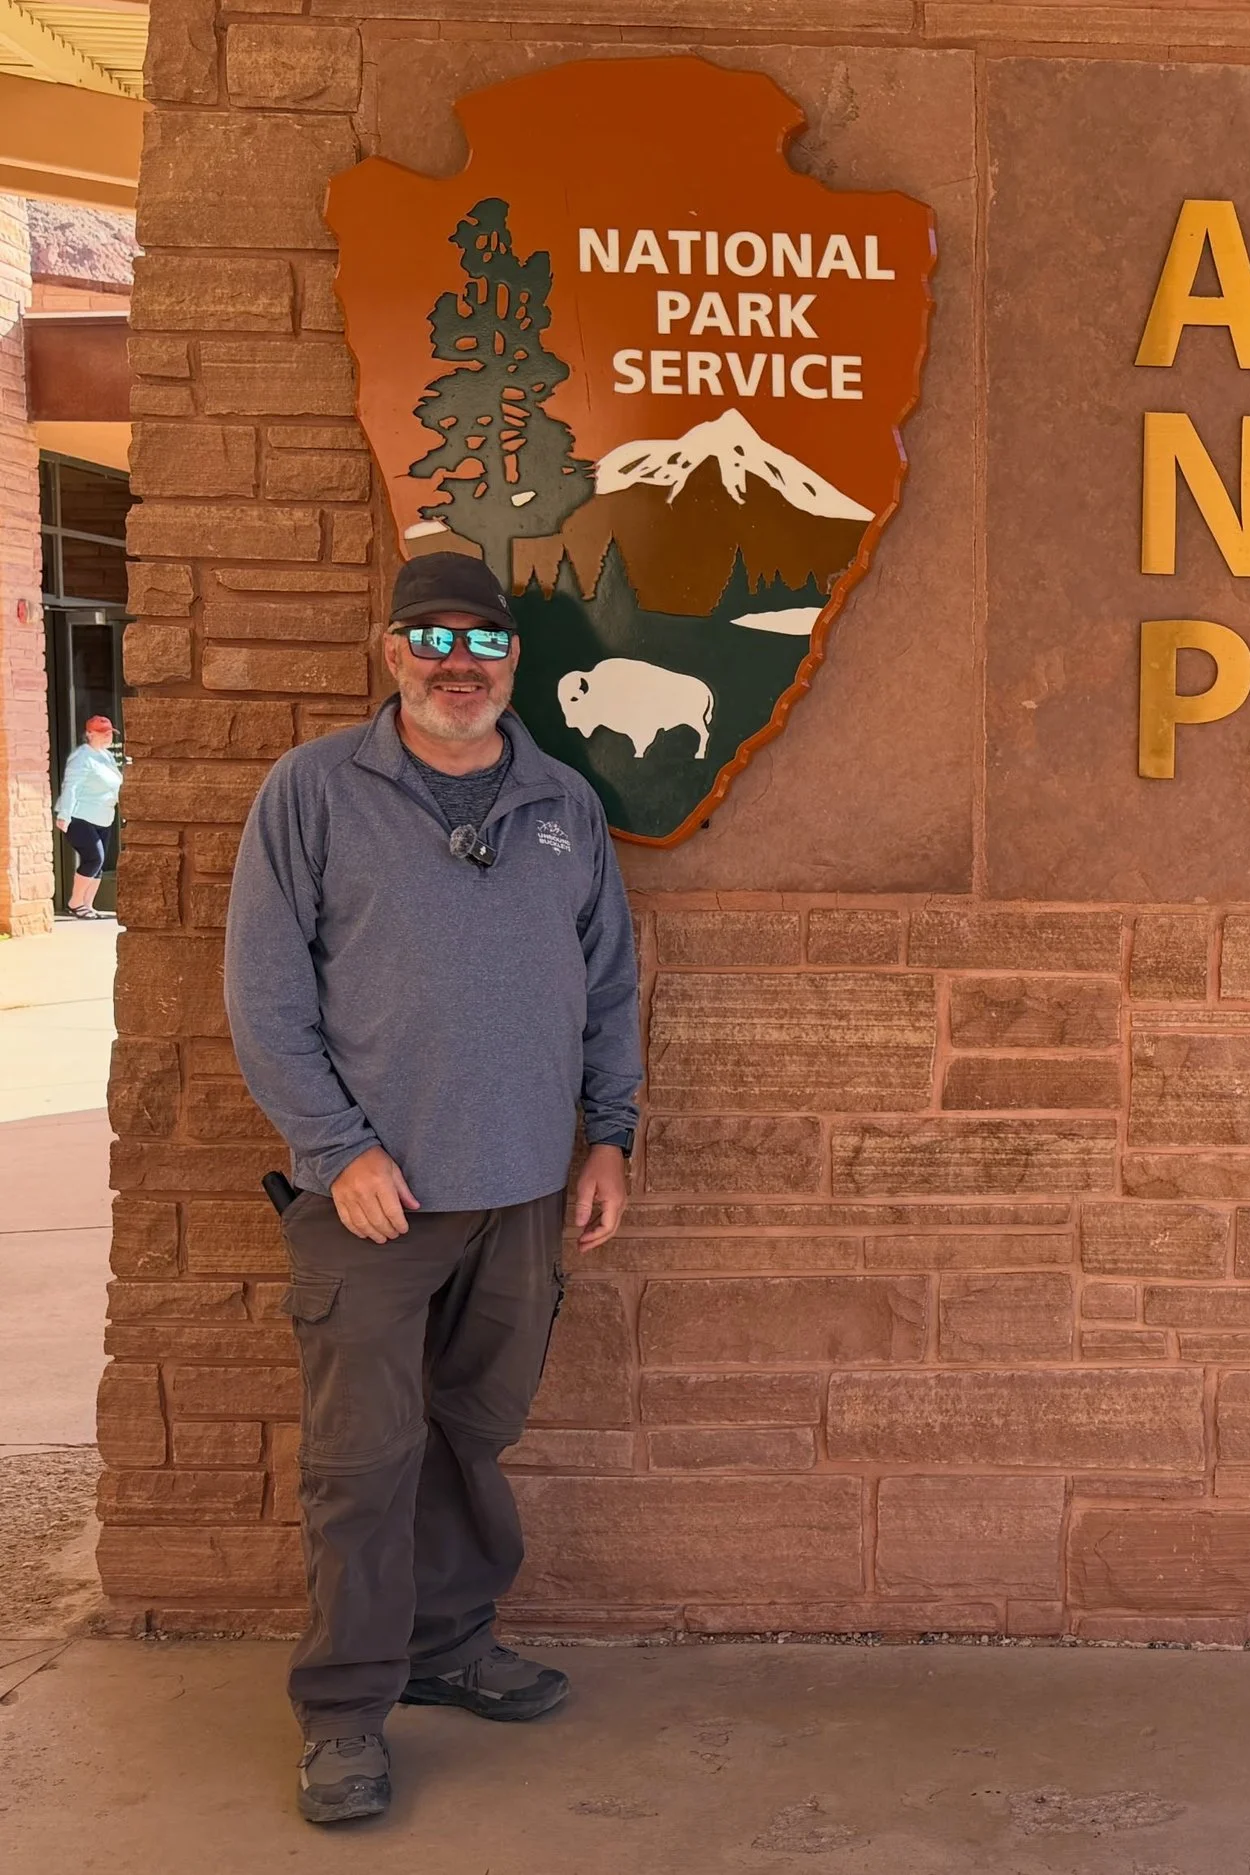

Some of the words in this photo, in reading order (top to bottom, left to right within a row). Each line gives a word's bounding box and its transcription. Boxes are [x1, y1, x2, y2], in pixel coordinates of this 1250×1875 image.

[579, 228, 895, 282] NATIONAL
[657, 290, 816, 340] PARK
[612, 349, 863, 400] SERVICE
